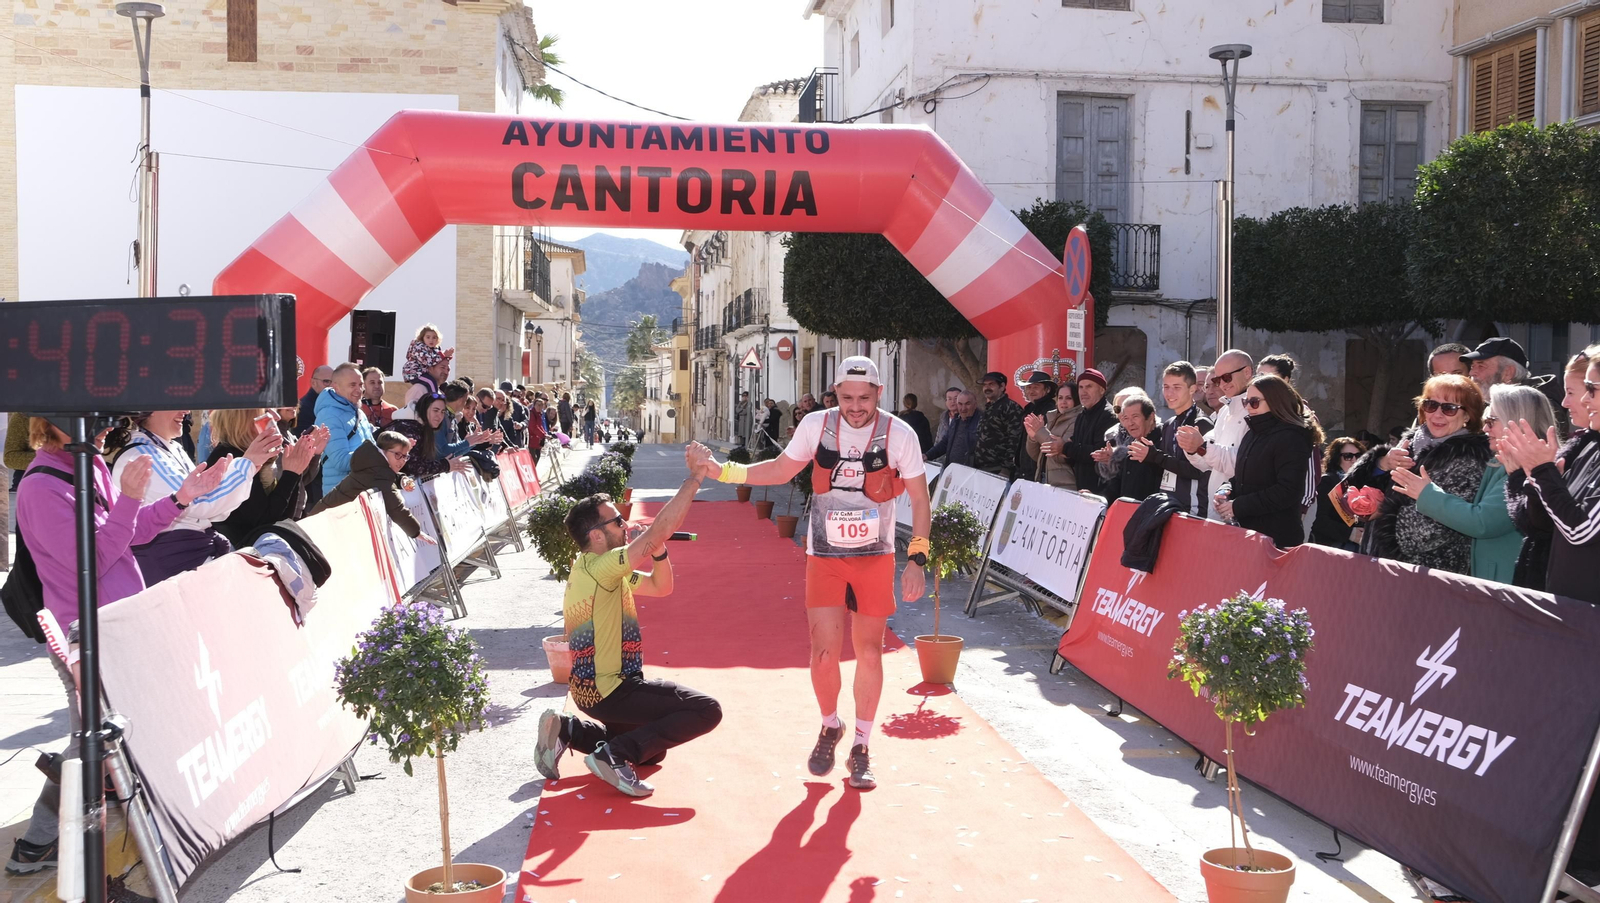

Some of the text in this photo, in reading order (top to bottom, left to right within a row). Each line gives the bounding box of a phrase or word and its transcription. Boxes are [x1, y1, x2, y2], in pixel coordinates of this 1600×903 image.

[501, 120, 830, 155] AYUNTAMIENTO
[511, 162, 818, 216] CANTORIA
[837, 523, 869, 538] 109
[1011, 520, 1082, 574] CANTORIA
[1021, 504, 1088, 540] AYUNTAMIENTO DE
[1091, 587, 1165, 637] TEAMERGY
[176, 694, 273, 809] TEAMERGY
[1334, 682, 1517, 777] TEAMERGY
[1349, 754, 1438, 806] www.teamergy.es
